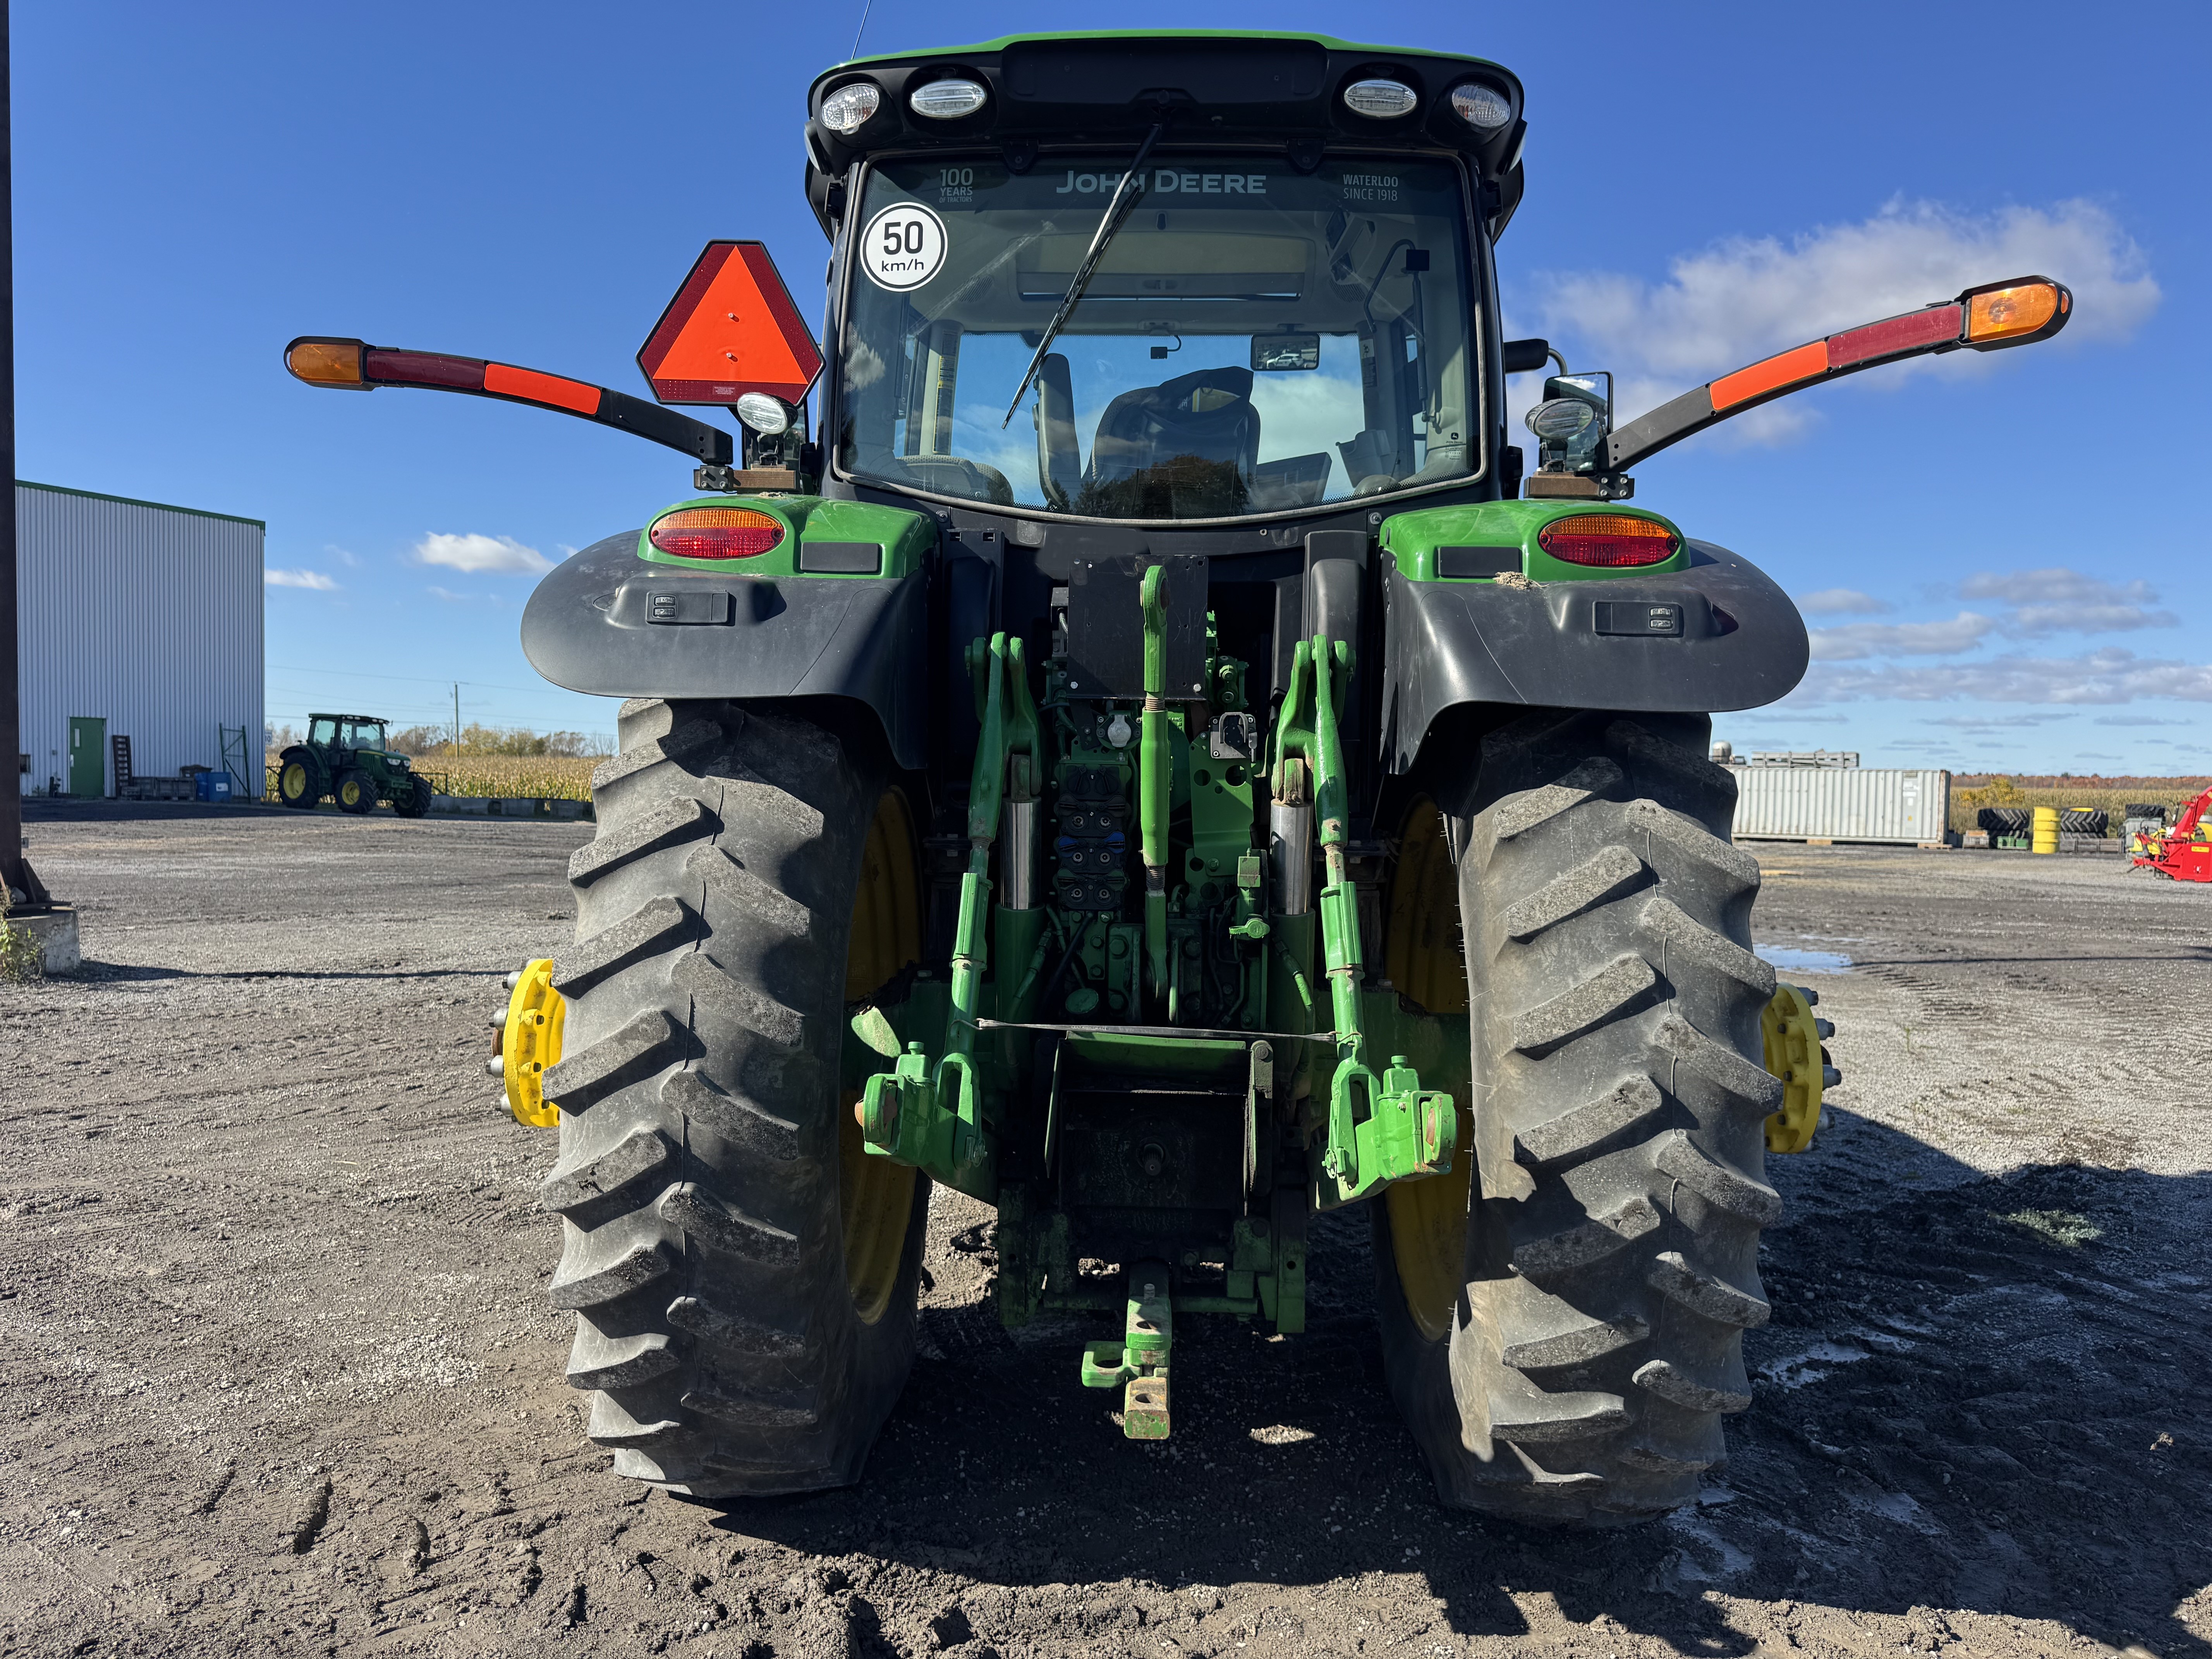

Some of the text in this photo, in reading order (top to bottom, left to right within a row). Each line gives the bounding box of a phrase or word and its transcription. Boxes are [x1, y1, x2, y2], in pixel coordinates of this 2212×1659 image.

[940, 168, 973, 186] 100
[1056, 170, 1266, 194] JOHN DEERE
[1343, 174, 1398, 187] WATERLOO
[940, 187, 973, 196] YEARS
[1343, 188, 1397, 201] SINCE 1918
[883, 221, 923, 255] 50
[881, 259, 924, 272] km/h
